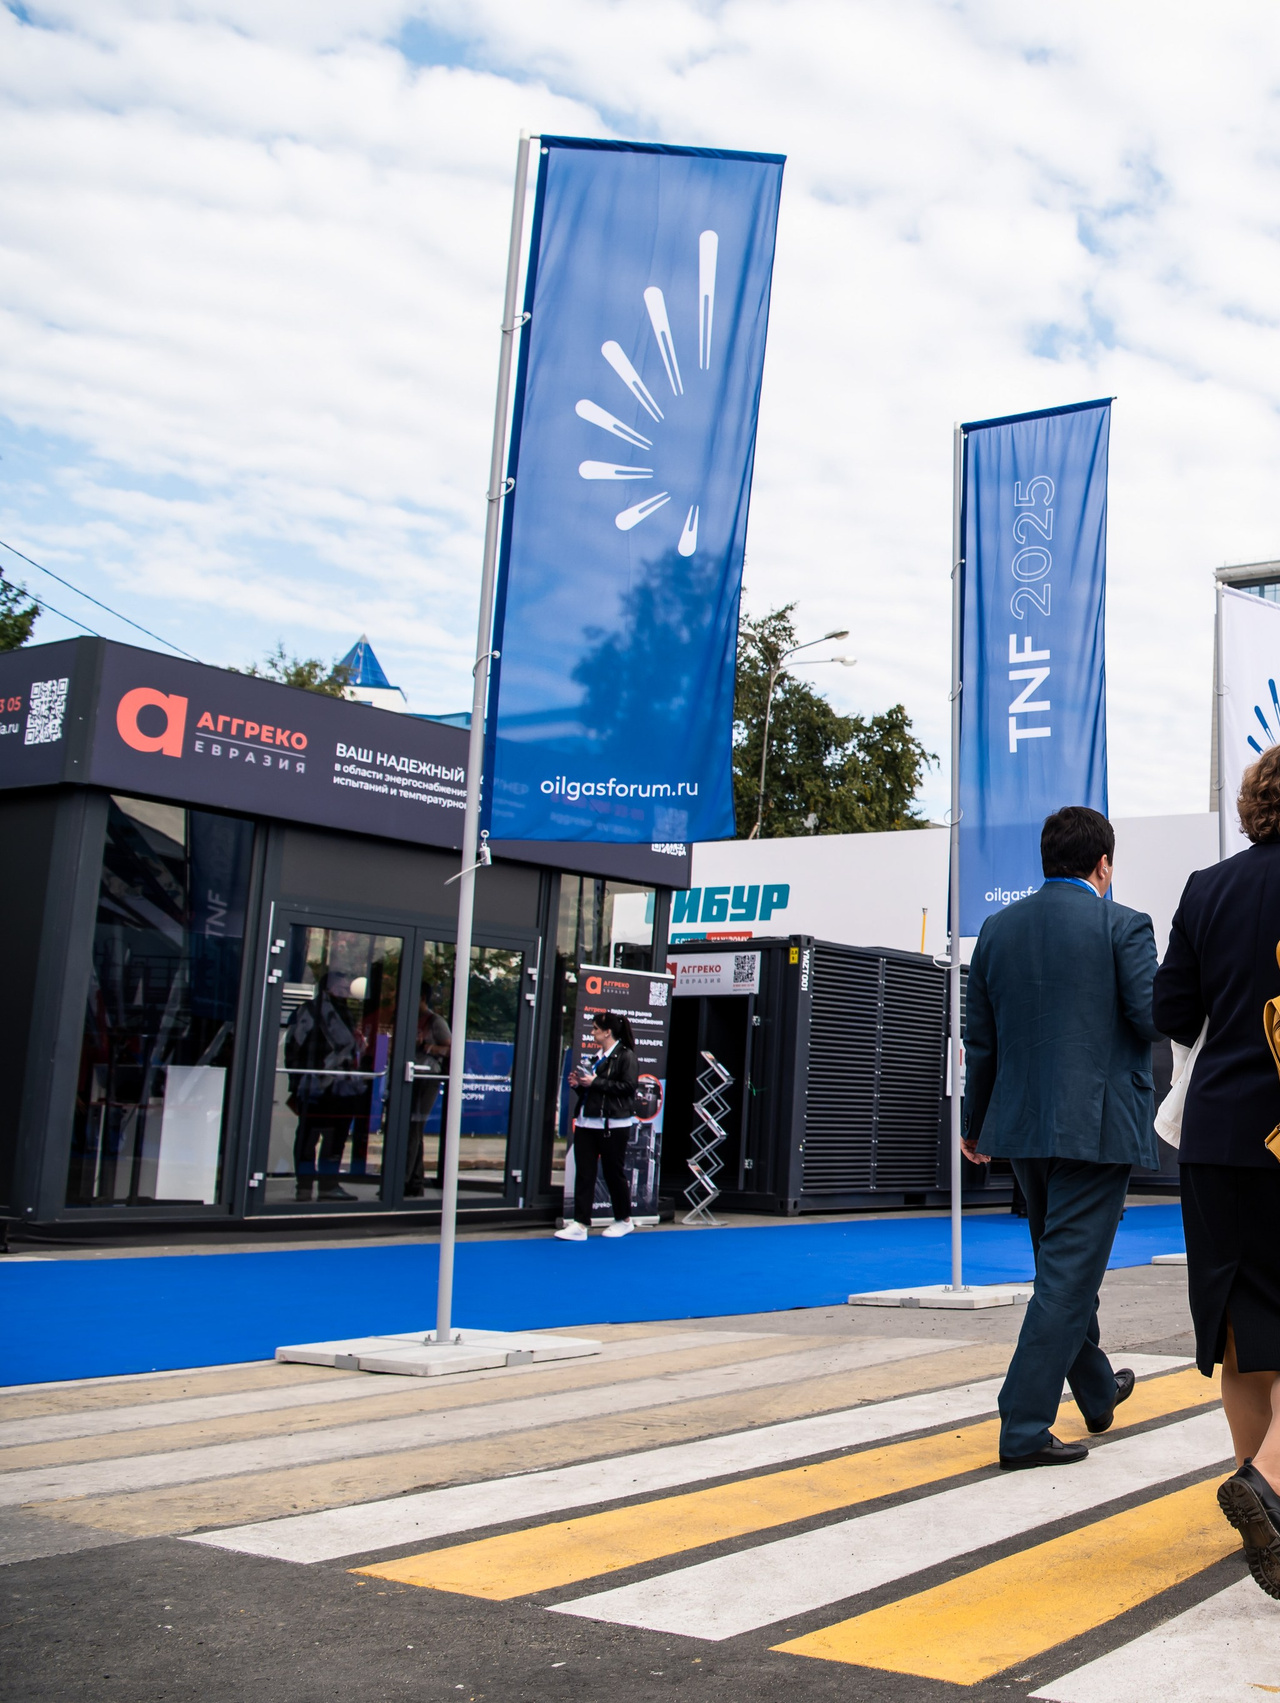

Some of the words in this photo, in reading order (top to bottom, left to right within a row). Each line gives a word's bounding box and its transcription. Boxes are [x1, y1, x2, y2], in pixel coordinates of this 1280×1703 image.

[1010, 475, 1055, 620] 2025
[1008, 633, 1052, 753] TNF
[196, 711, 308, 750] АГГРЕКО
[194, 740, 306, 774] ЕВРАЗИЯ
[335, 743, 373, 763] ВАШ
[376, 752, 465, 783] НАДЕЖНЫЙ
[333, 776, 388, 794] испытаний
[390, 788, 397, 796] и
[399, 789, 482, 812] температурно
[334, 763, 341, 771] в
[343, 765, 383, 781] области
[384, 774, 468, 798] энергоснабжения
[540, 775, 698, 800] oilgasforum.ru
[645, 884, 790, 924] ИБУР
[603, 980, 630, 989] АГГРЕКО
[681, 964, 722, 974] АГГРЕКО
